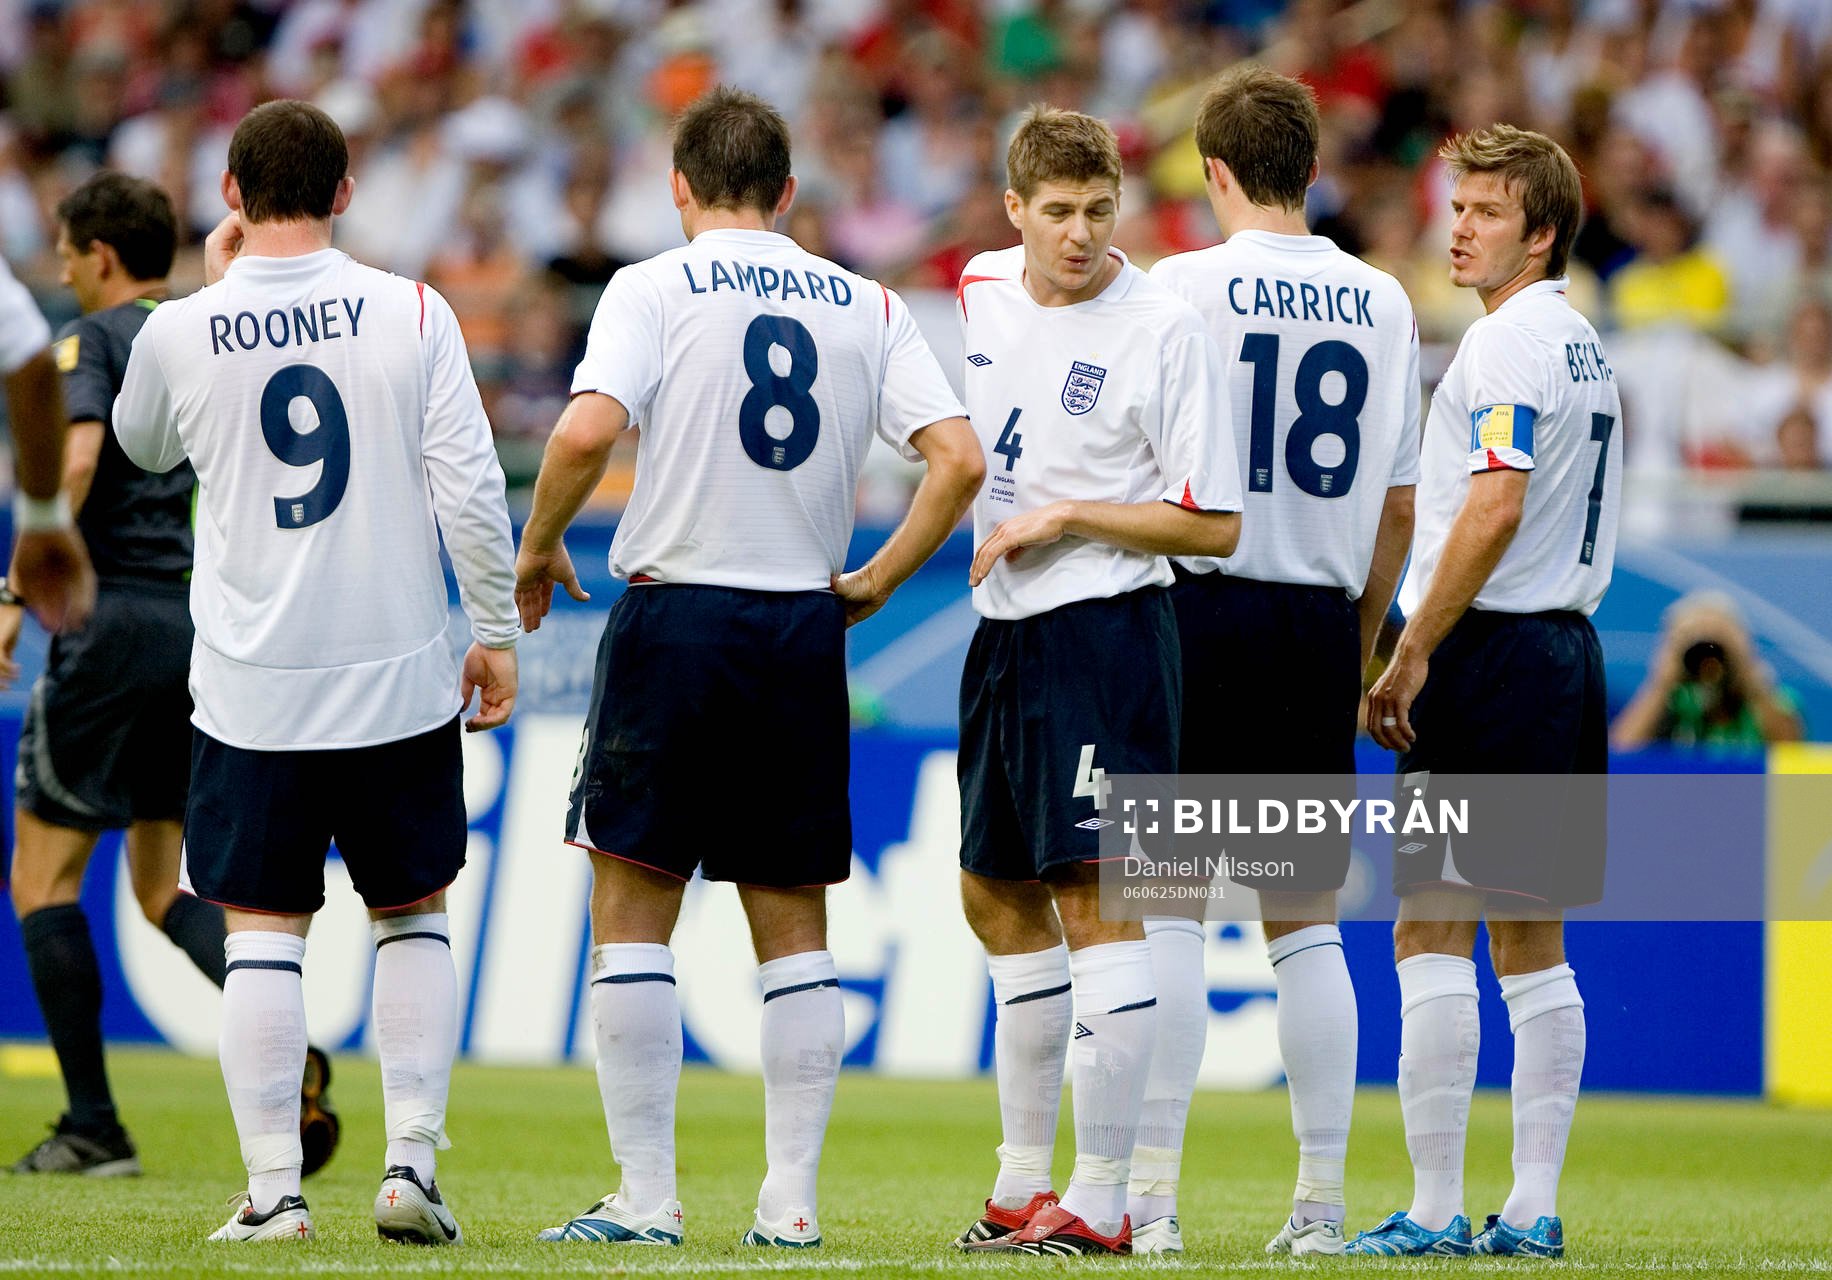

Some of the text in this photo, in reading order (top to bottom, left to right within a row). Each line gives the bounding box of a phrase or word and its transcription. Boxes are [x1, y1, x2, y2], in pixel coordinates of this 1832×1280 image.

[683, 260, 852, 306] LAMPARD
[1228, 277, 1374, 327] CARRICK
[210, 297, 364, 355] ROONEY
[739, 314, 820, 471] 8
[1073, 362, 1105, 376] ENGLAND
[993, 407, 1023, 472] 4
[1239, 333, 1368, 498] 18
[260, 364, 351, 529] 9
[991, 487, 1015, 497] ECUADOR
[994, 475, 1015, 484] ENGLAND
[1579, 412, 1615, 566] 7
[1072, 744, 1112, 809] 4
